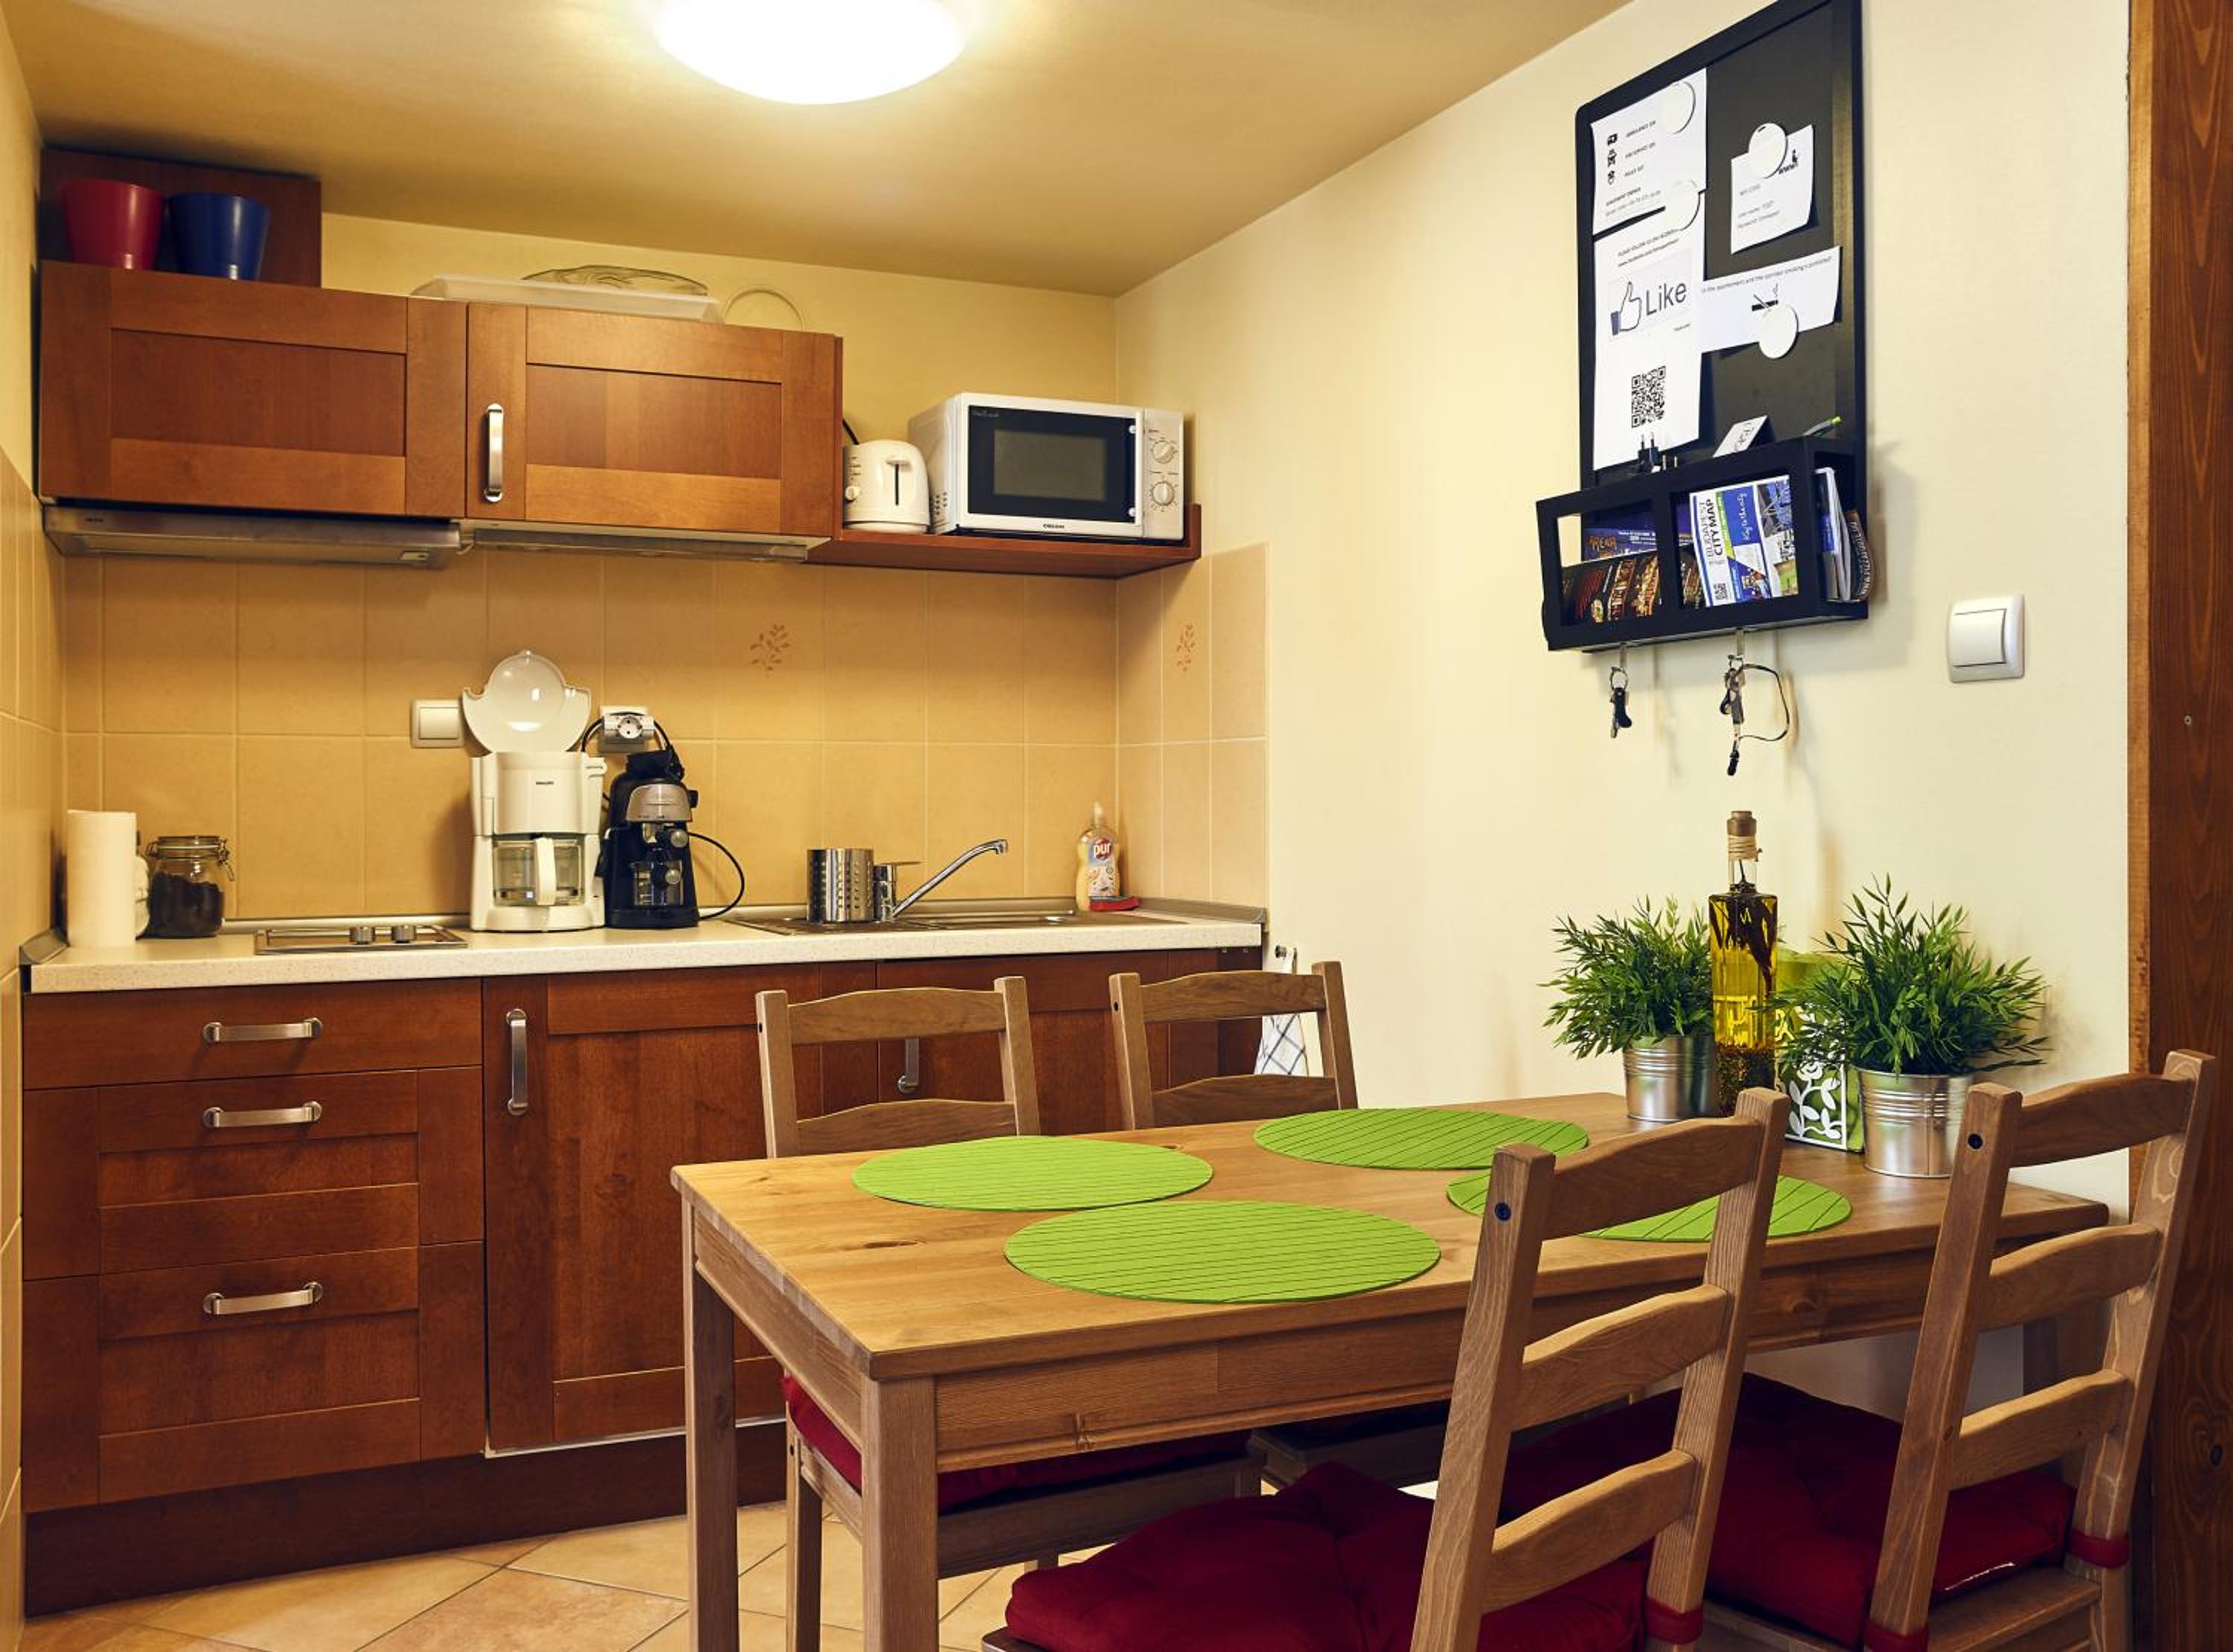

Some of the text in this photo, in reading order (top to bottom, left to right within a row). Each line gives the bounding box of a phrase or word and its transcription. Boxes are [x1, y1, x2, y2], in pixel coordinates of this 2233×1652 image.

[1646, 282, 1687, 316] Like
[1705, 499, 1723, 556] CITY MAP
[1093, 842, 1111, 857] pur
